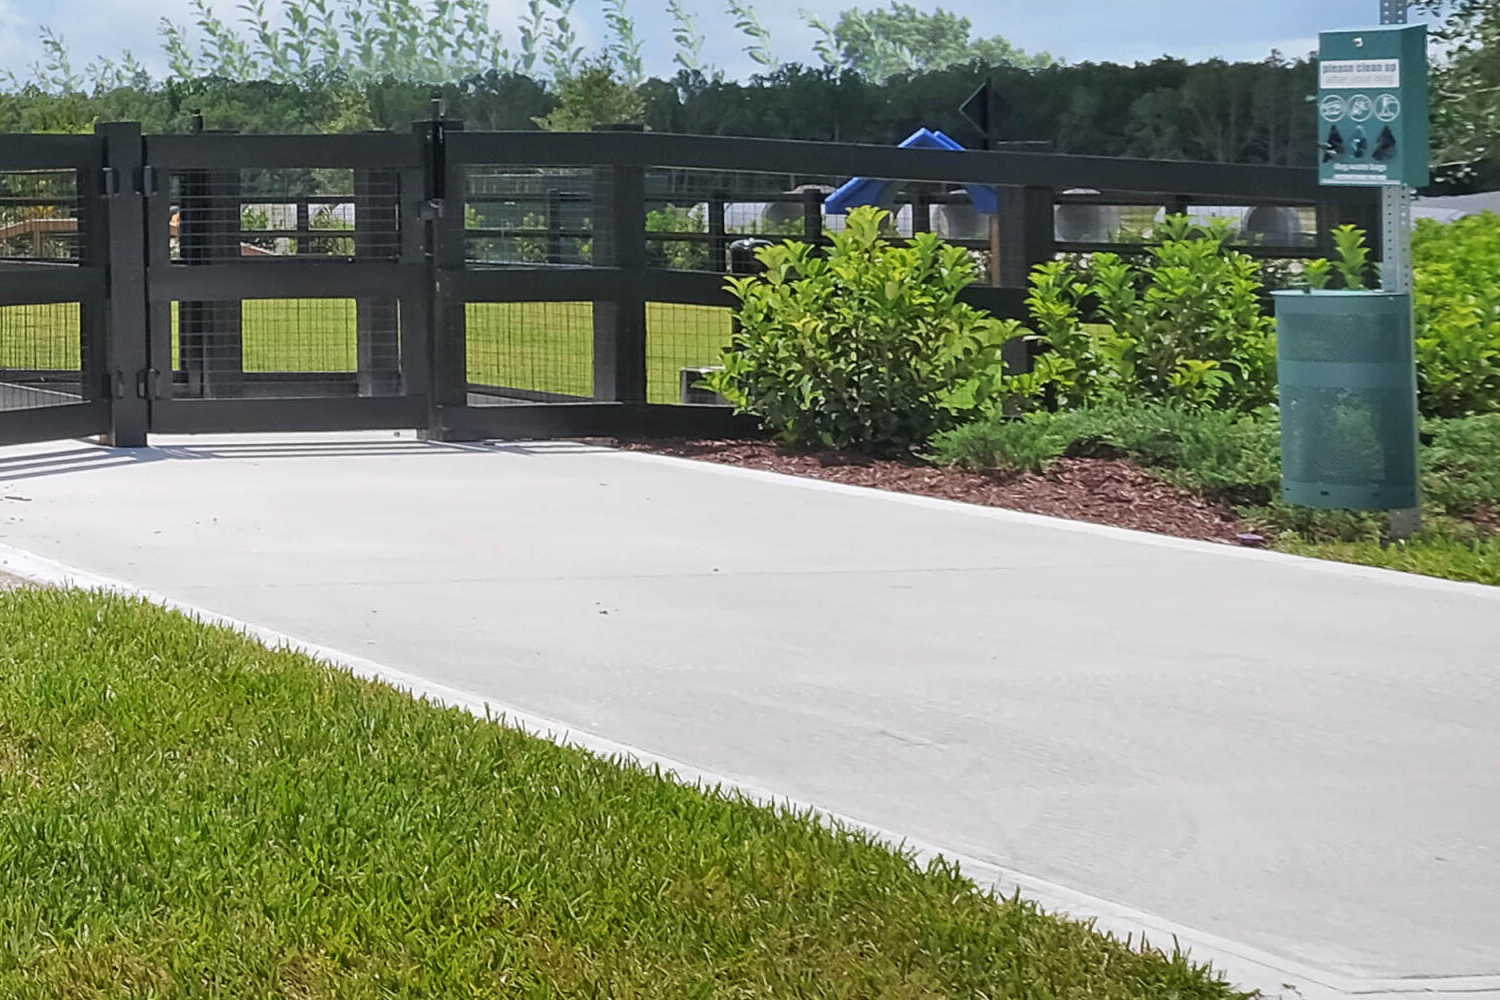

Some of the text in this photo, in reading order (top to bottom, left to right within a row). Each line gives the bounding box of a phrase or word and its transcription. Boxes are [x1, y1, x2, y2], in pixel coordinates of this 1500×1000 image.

[1322, 62, 1397, 74] please clean up
